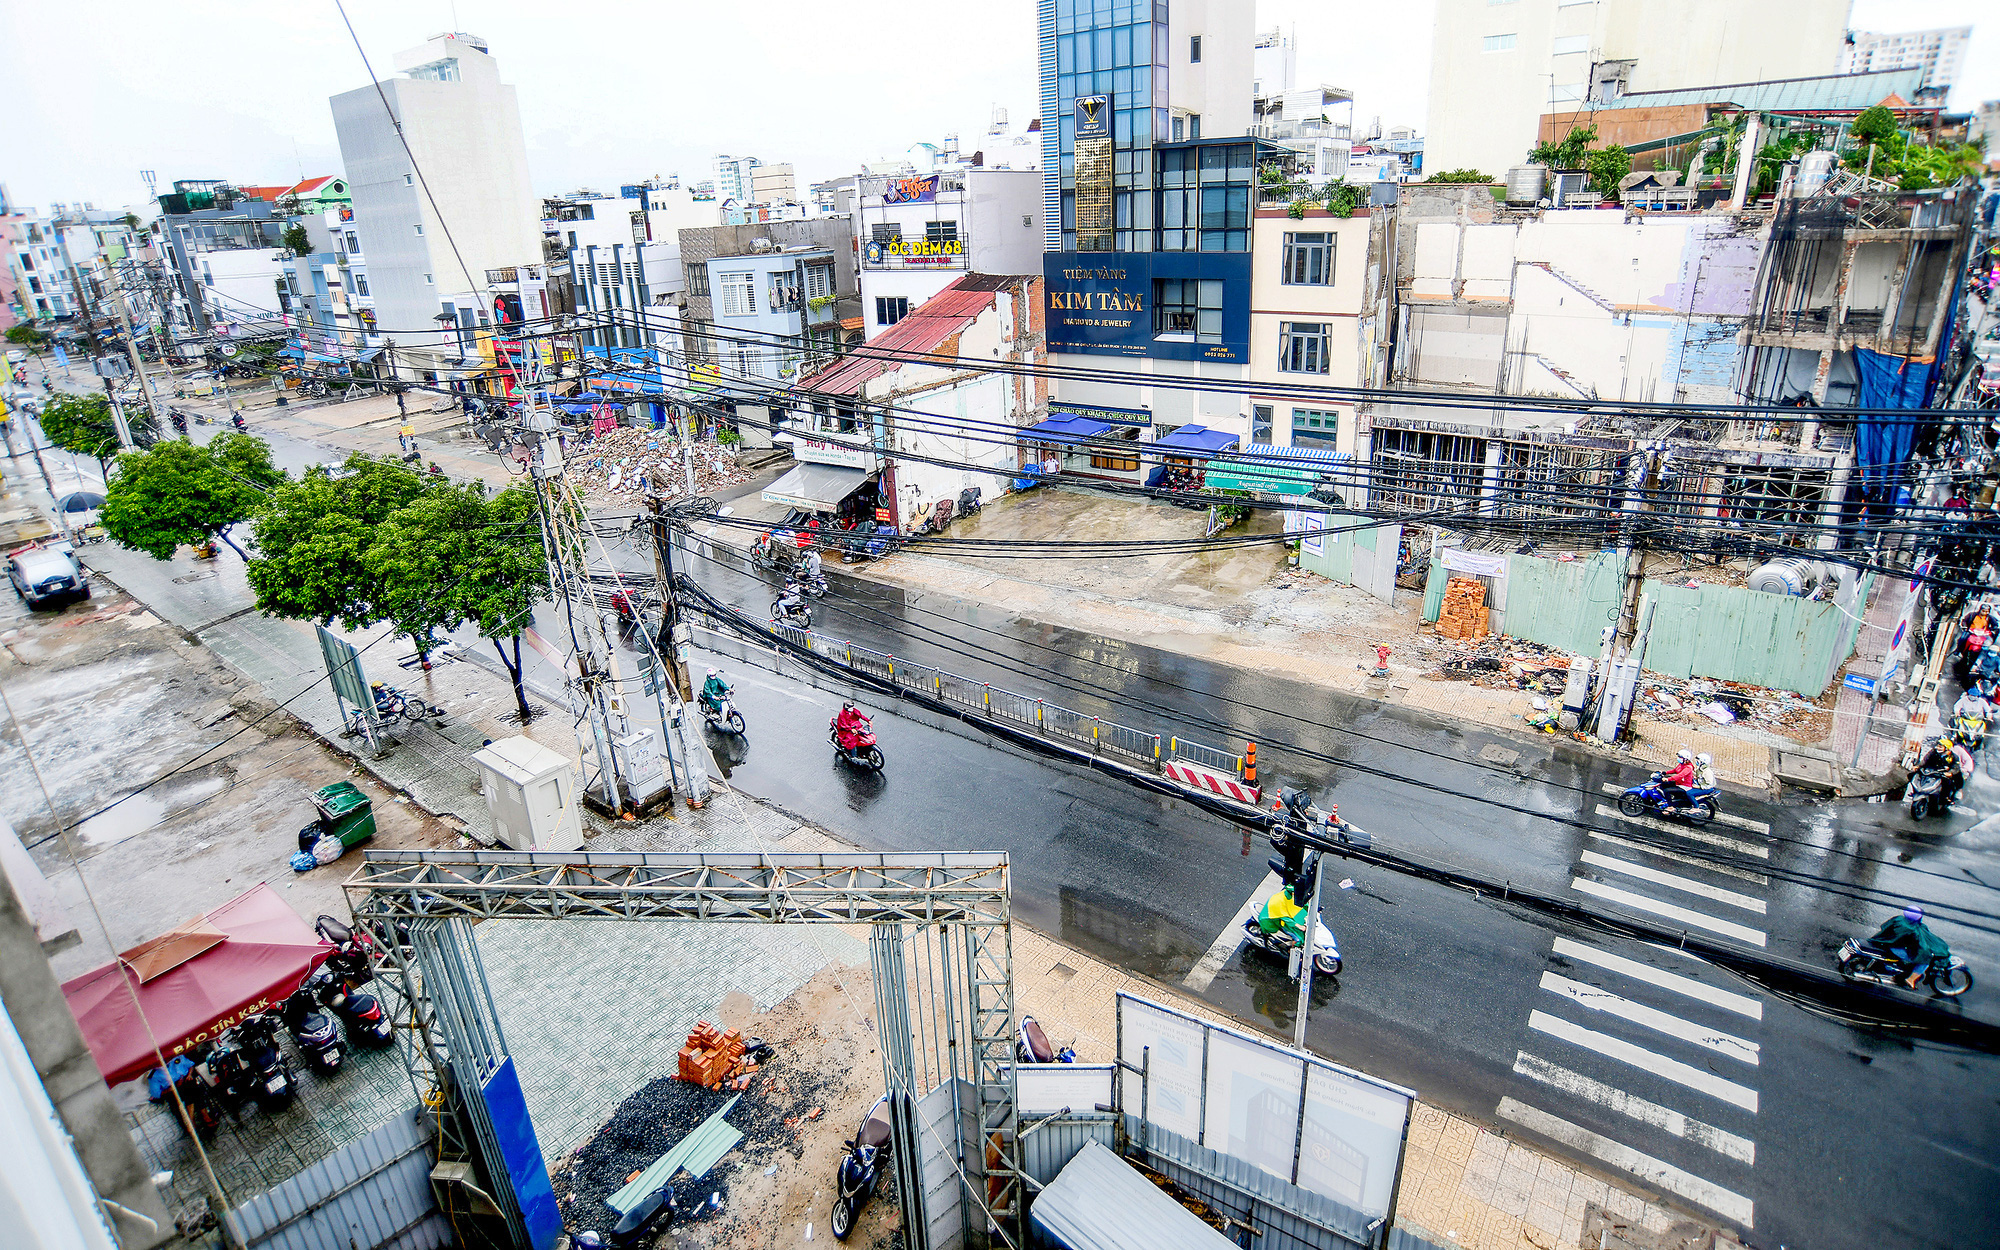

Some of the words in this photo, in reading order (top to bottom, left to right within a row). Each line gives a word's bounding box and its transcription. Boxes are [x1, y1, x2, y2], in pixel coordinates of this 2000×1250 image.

[898, 176, 933, 200] Tiger
[888, 235, 910, 255] ỐC
[944, 240, 962, 254] 68
[1063, 266, 1092, 282] TIỆM
[1096, 266, 1127, 280] VÀNG
[1050, 292, 1092, 310] KIM
[1096, 287, 1144, 312] TÂM
[1063, 318, 1094, 326] DIAMOND
[1100, 318, 1132, 328] JEWELRY
[173, 1032, 208, 1055] BẢO
[210, 1016, 235, 1034] TÍN
[238, 997, 269, 1020] K&K
